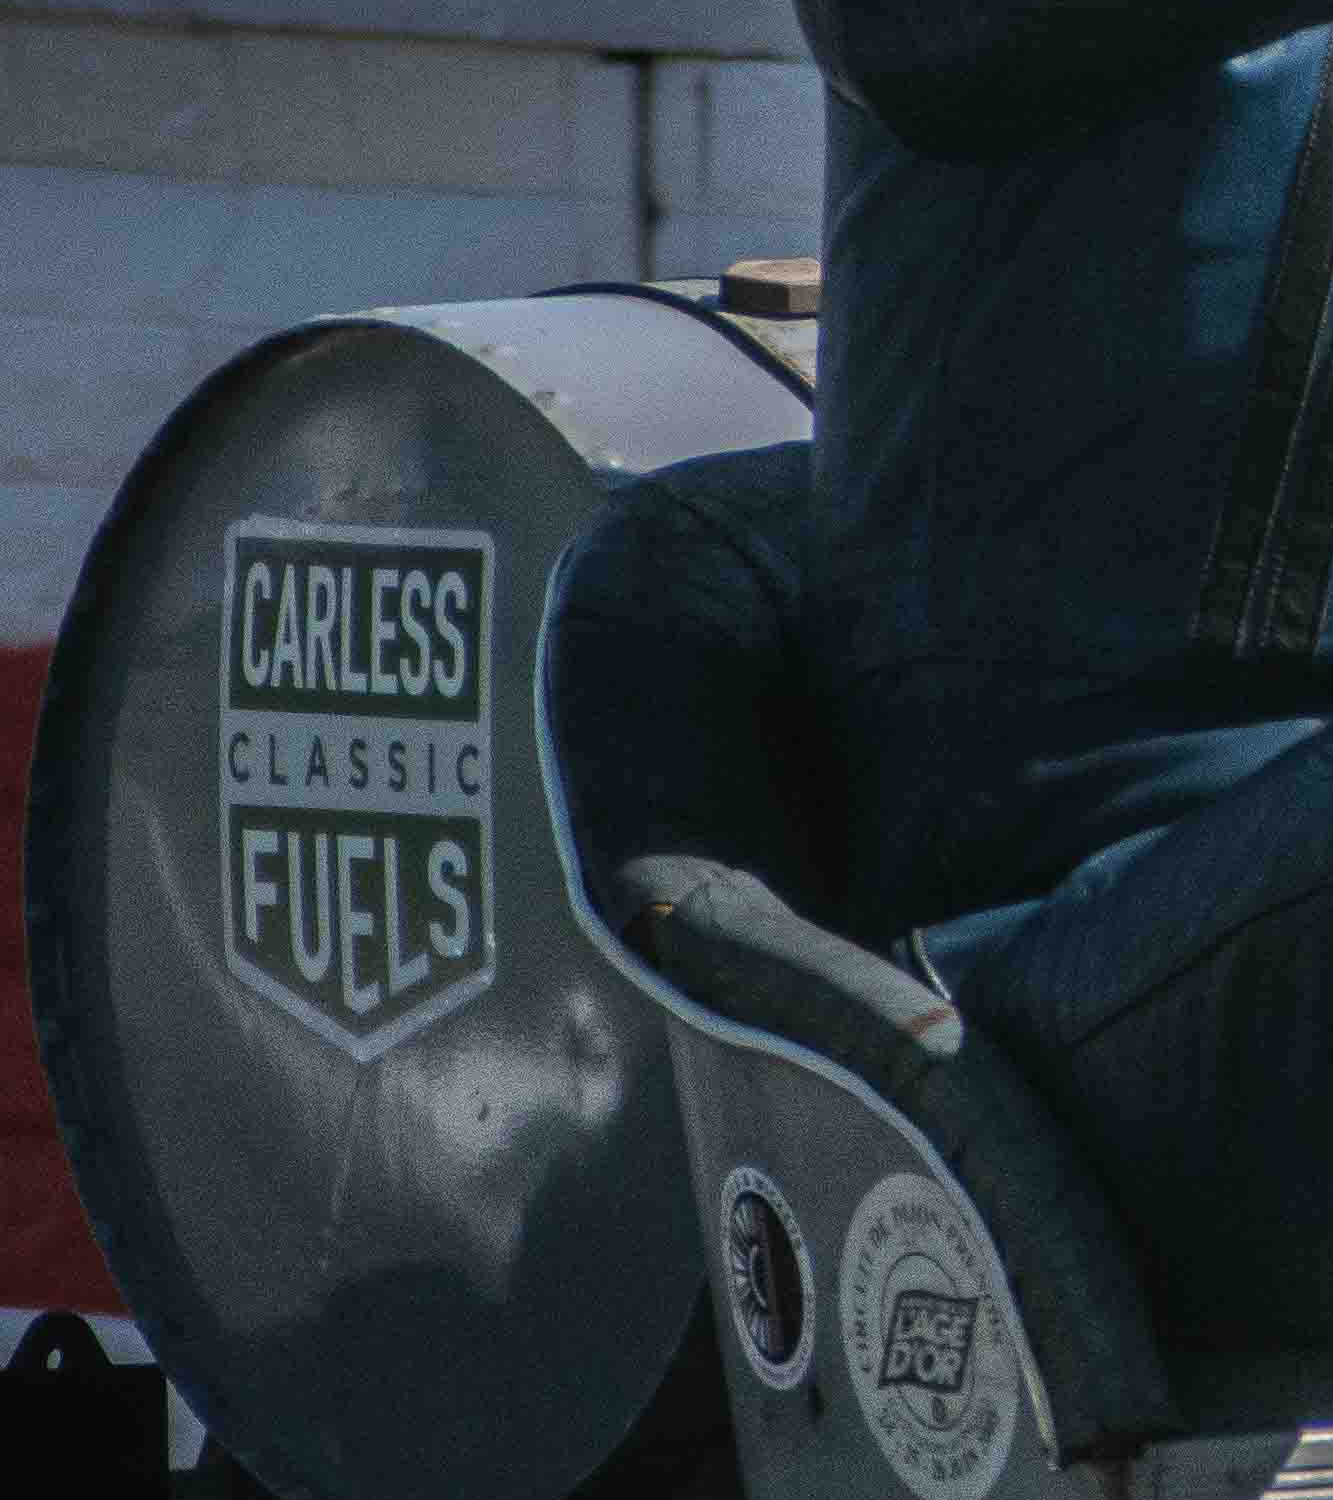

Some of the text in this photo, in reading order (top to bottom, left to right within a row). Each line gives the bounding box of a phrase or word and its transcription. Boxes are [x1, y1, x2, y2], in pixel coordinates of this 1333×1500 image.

[241, 560, 469, 699] CARLESS
[228, 730, 483, 797] CLASSIC
[241, 827, 472, 1016] FUELS
[886, 1340, 963, 1386] D'OR
